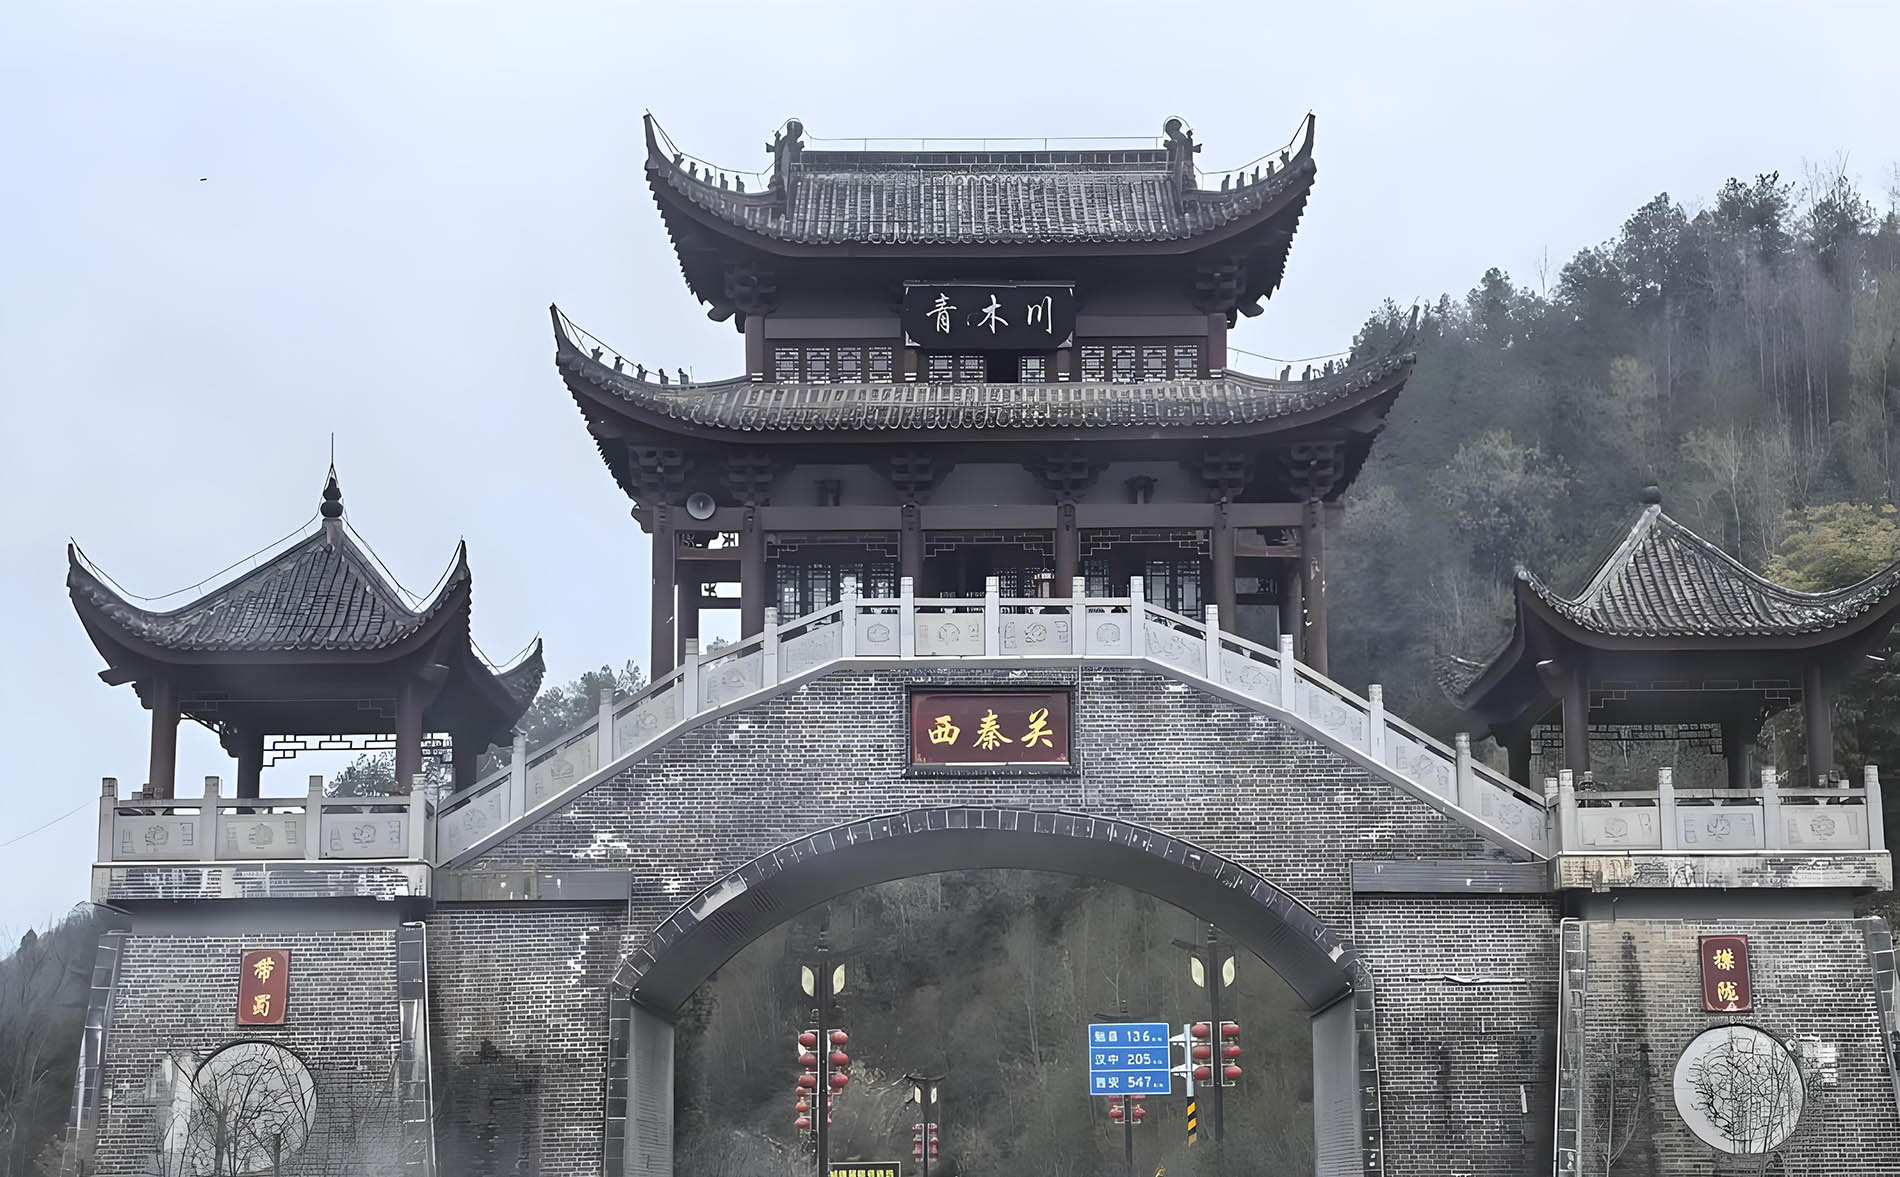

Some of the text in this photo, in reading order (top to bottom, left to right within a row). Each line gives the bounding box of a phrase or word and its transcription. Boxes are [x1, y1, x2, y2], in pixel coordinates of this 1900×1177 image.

[926, 293, 1053, 334] 青木川
[928, 708, 1053, 750] 西秦关
